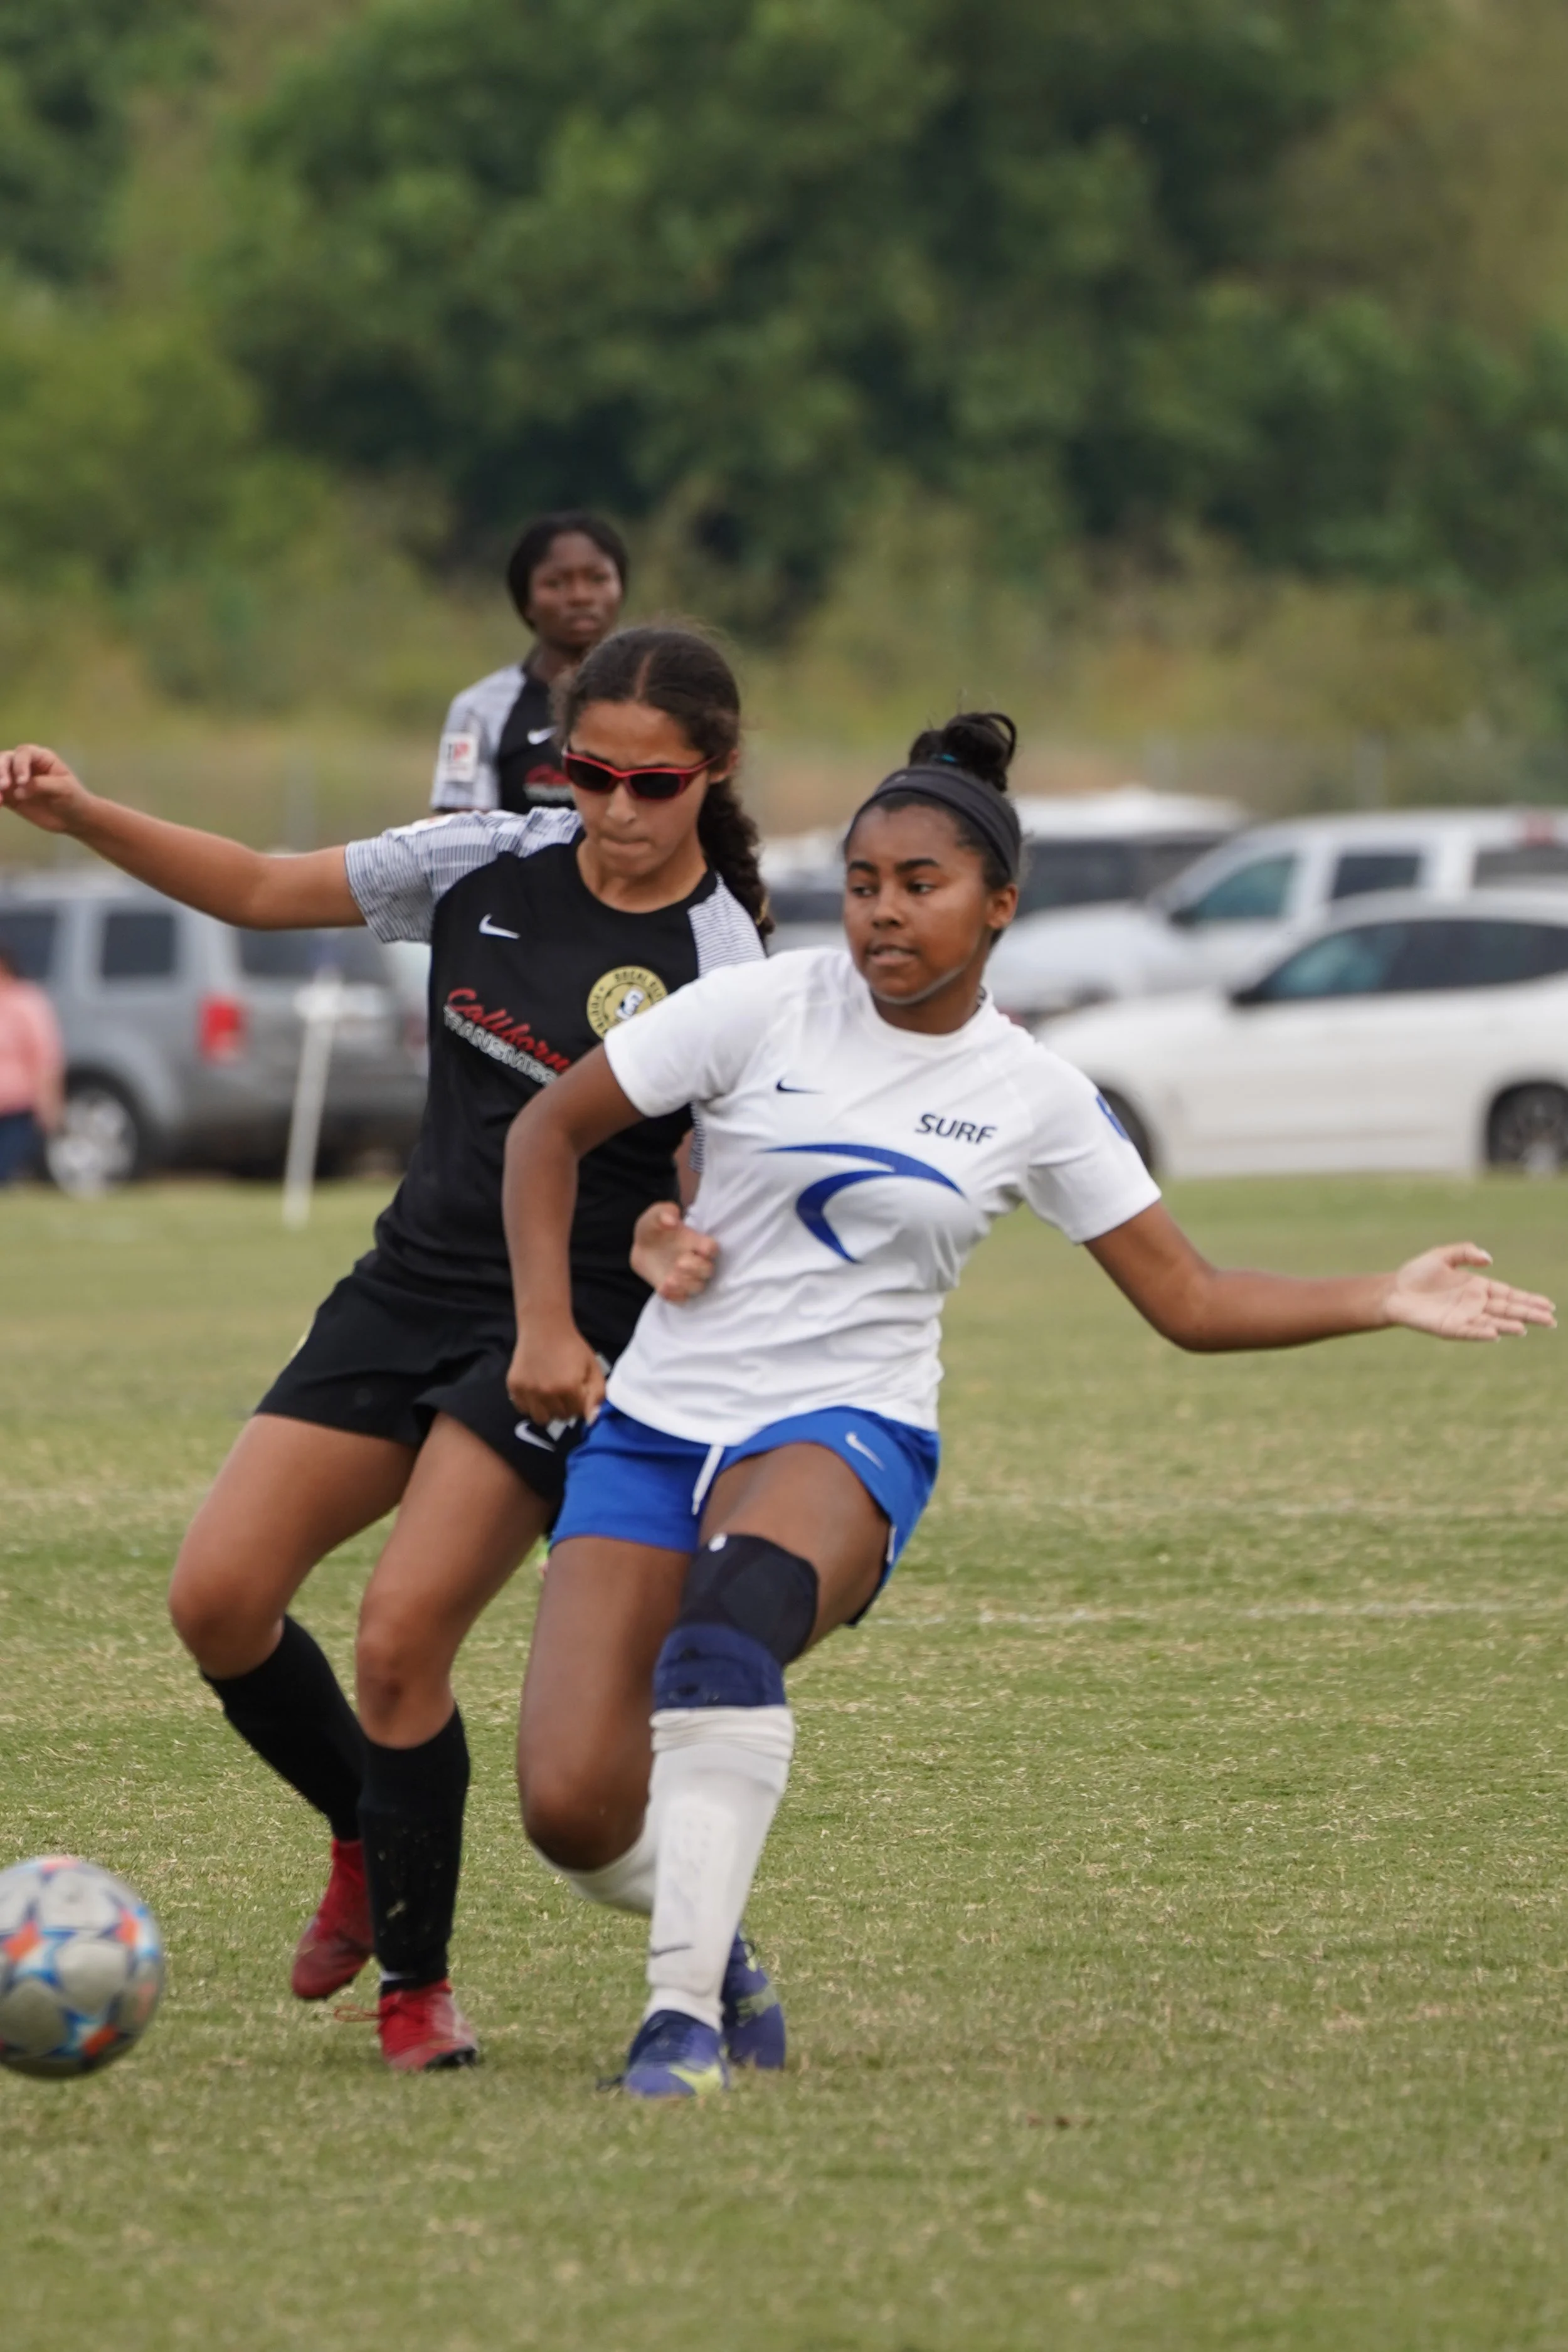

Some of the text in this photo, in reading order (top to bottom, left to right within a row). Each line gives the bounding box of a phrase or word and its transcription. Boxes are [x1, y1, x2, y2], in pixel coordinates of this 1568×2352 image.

[443, 1005, 558, 1086] TRANSMISS
[448, 988, 569, 1072] Californ
[914, 1113, 997, 1144] SURF
